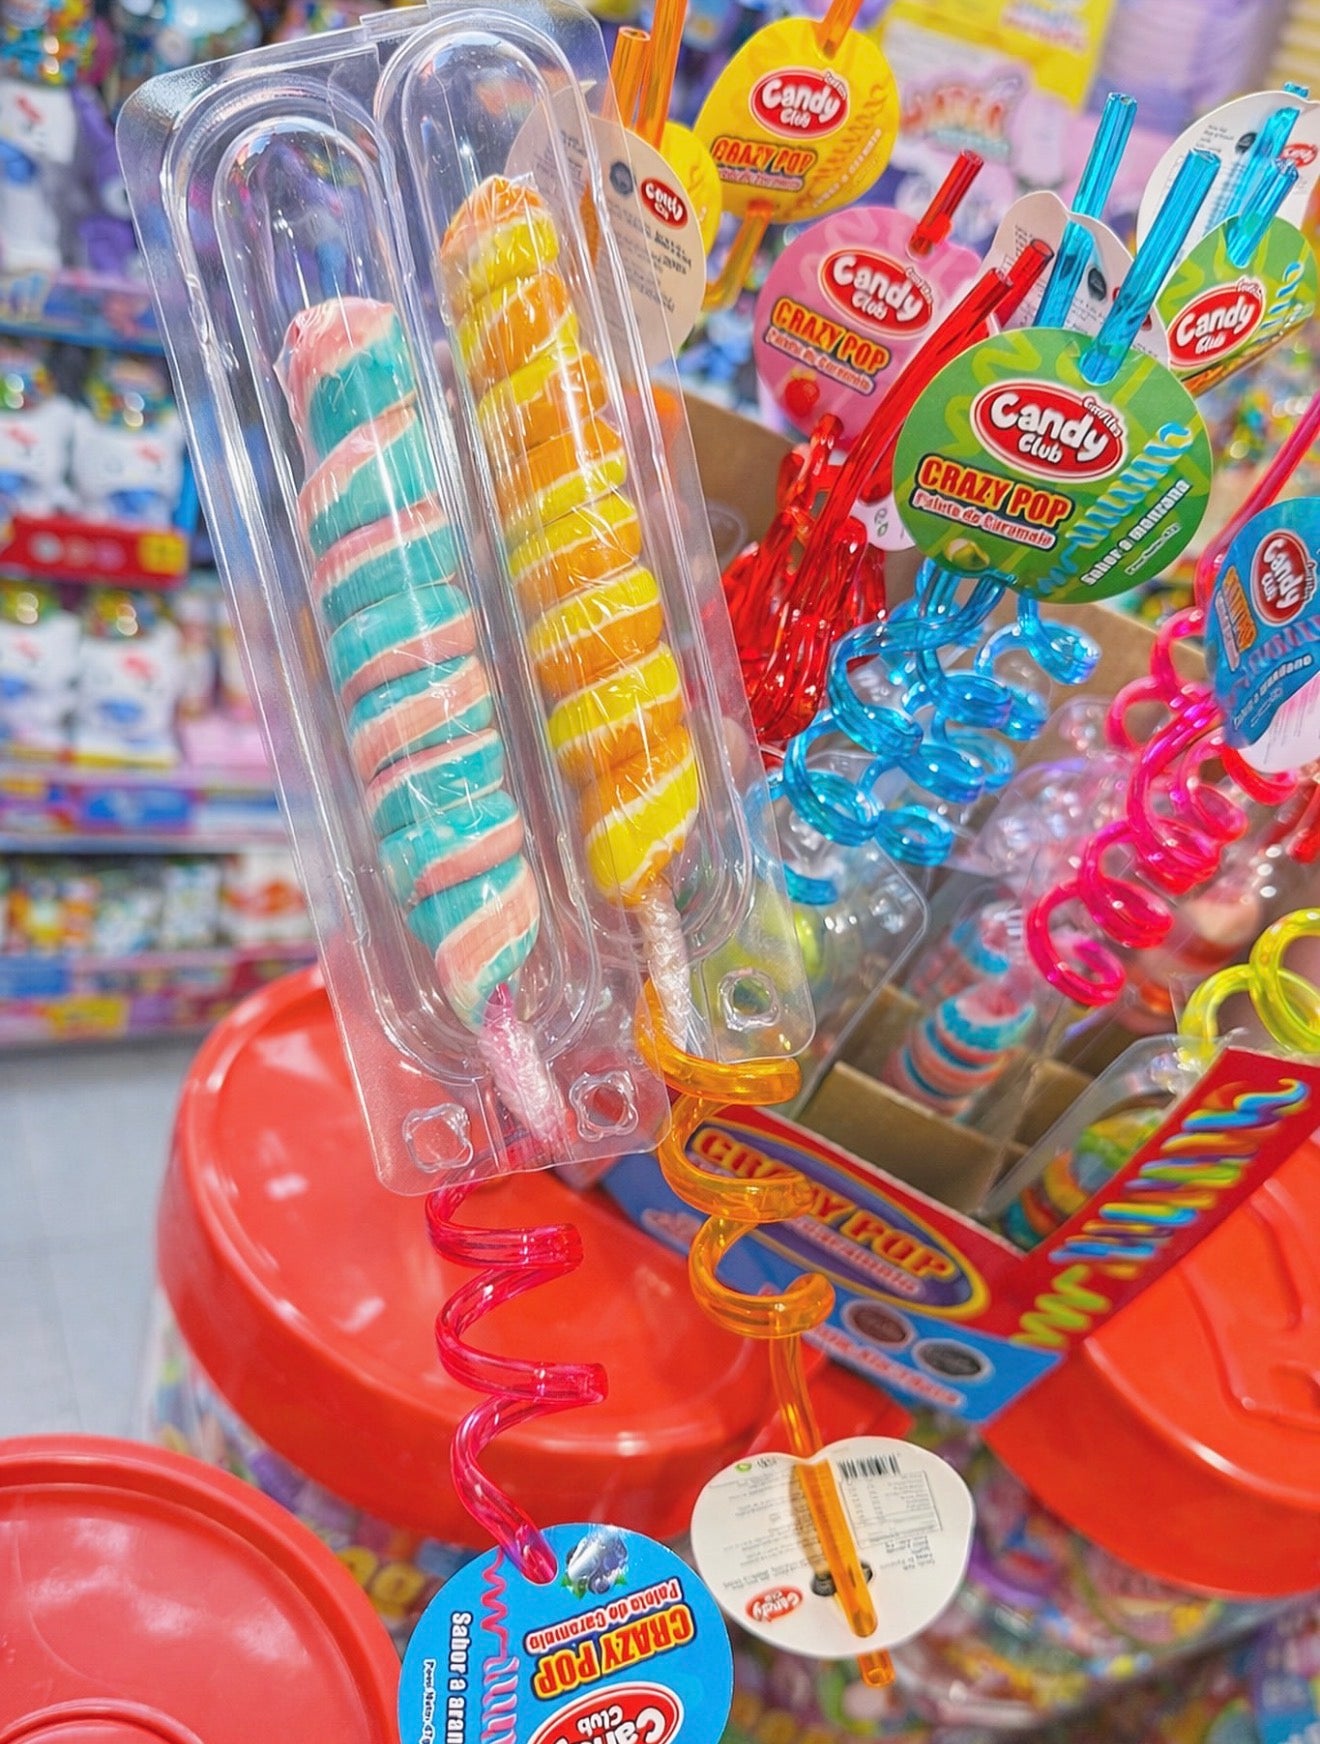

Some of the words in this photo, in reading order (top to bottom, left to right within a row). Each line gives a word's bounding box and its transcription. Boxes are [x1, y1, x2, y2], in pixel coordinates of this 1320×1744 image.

[761, 78, 841, 124] Candy
[779, 107, 811, 129] Club
[711, 136, 775, 171] CRAZY
[770, 145, 818, 177] POP
[832, 254, 924, 322] Candy
[851, 290, 888, 321] Club
[771, 297, 847, 354] CRAZY
[836, 331, 891, 376] POP
[1175, 294, 1256, 348] Candy
[1194, 332, 1228, 356] Club
[990, 391, 1110, 463] Candy
[1017, 432, 1063, 464] Club
[918, 455, 1015, 512] CRAZY
[1005, 482, 1073, 528] POP
[1263, 537, 1301, 610] Candy
[692, 1127, 857, 1225] CRY
[840, 1209, 959, 1281] POP
[450, 1611, 472, 1676] Sabor
[599, 1604, 695, 1674] CRAZY
[449, 1674, 467, 1692] a
[533, 1641, 602, 1700] POP
[556, 1706, 667, 1744] Can
[576, 1704, 624, 1736] Club
